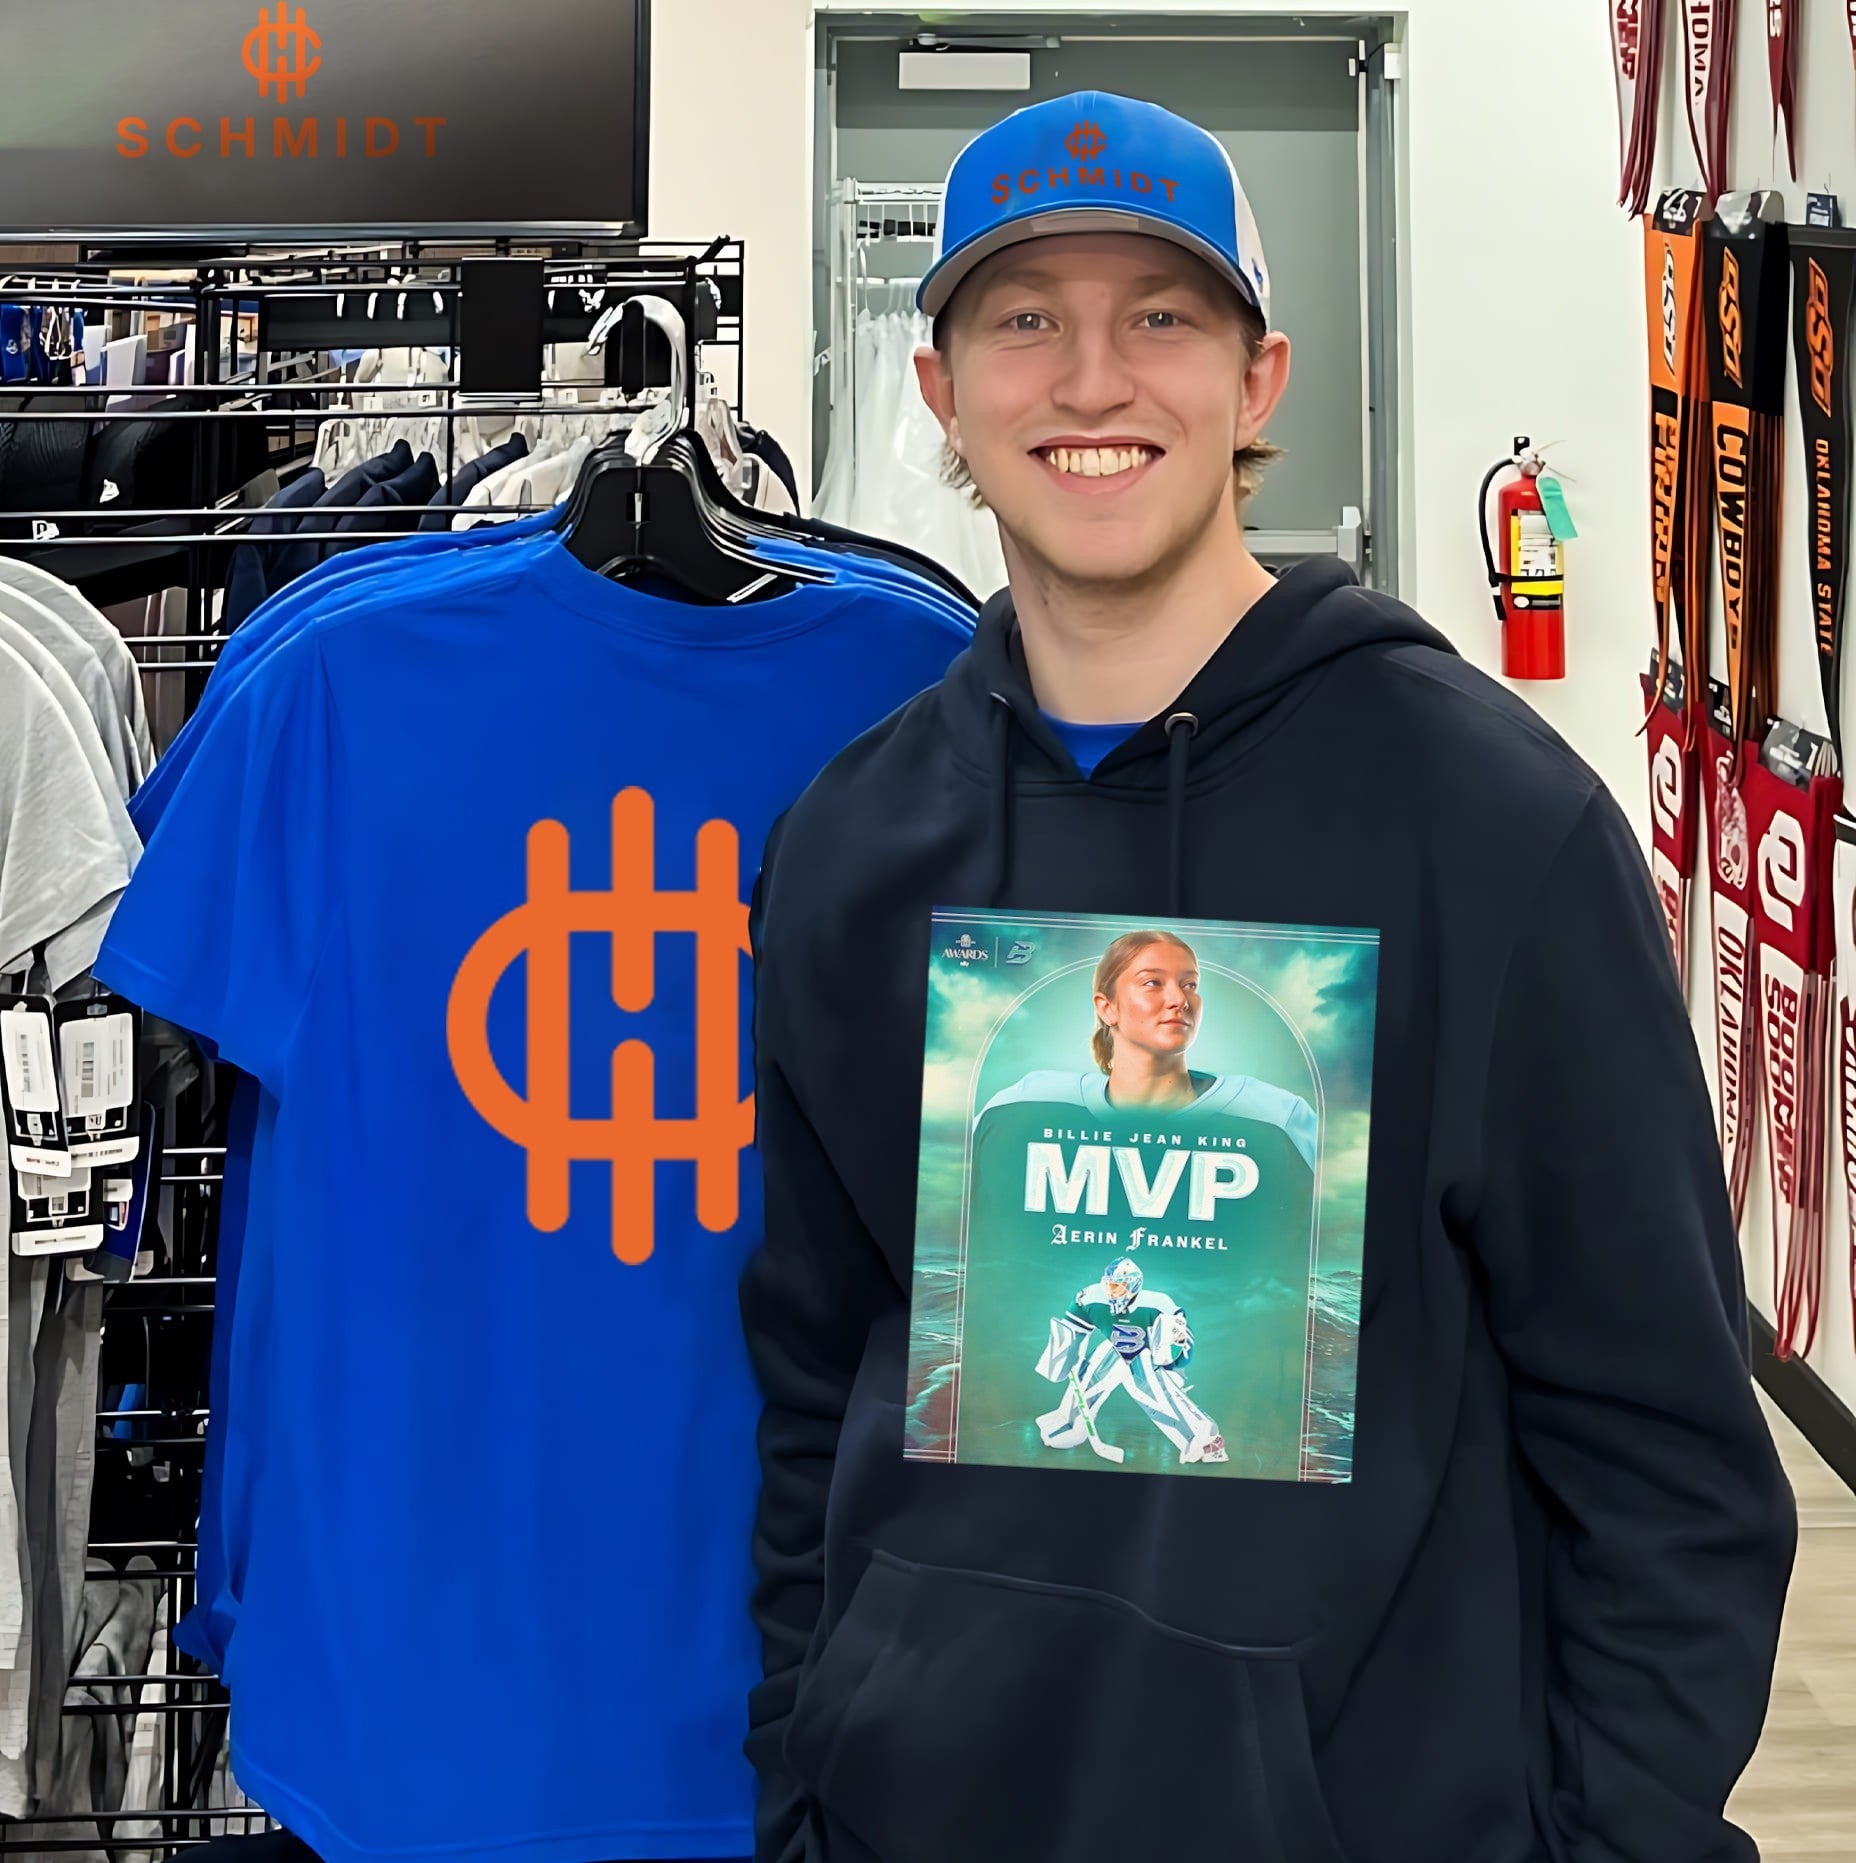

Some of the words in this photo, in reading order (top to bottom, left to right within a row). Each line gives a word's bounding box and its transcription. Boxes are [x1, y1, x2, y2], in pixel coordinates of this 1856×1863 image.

[116, 117, 447, 158] SCHMIDT
[992, 167, 1179, 204] SCHMIDT
[1815, 438, 1832, 570] OKLAHOMA
[941, 948, 989, 961] AWARDS
[1718, 926, 1746, 1144] OKLAHOMA
[1043, 1128, 1112, 1142] BILLIE
[1129, 1133, 1181, 1146] JEAN
[1198, 1136, 1246, 1149] KING
[1024, 1141, 1260, 1222] MVP
[1126, 1226, 1228, 1252] FRANKEL
